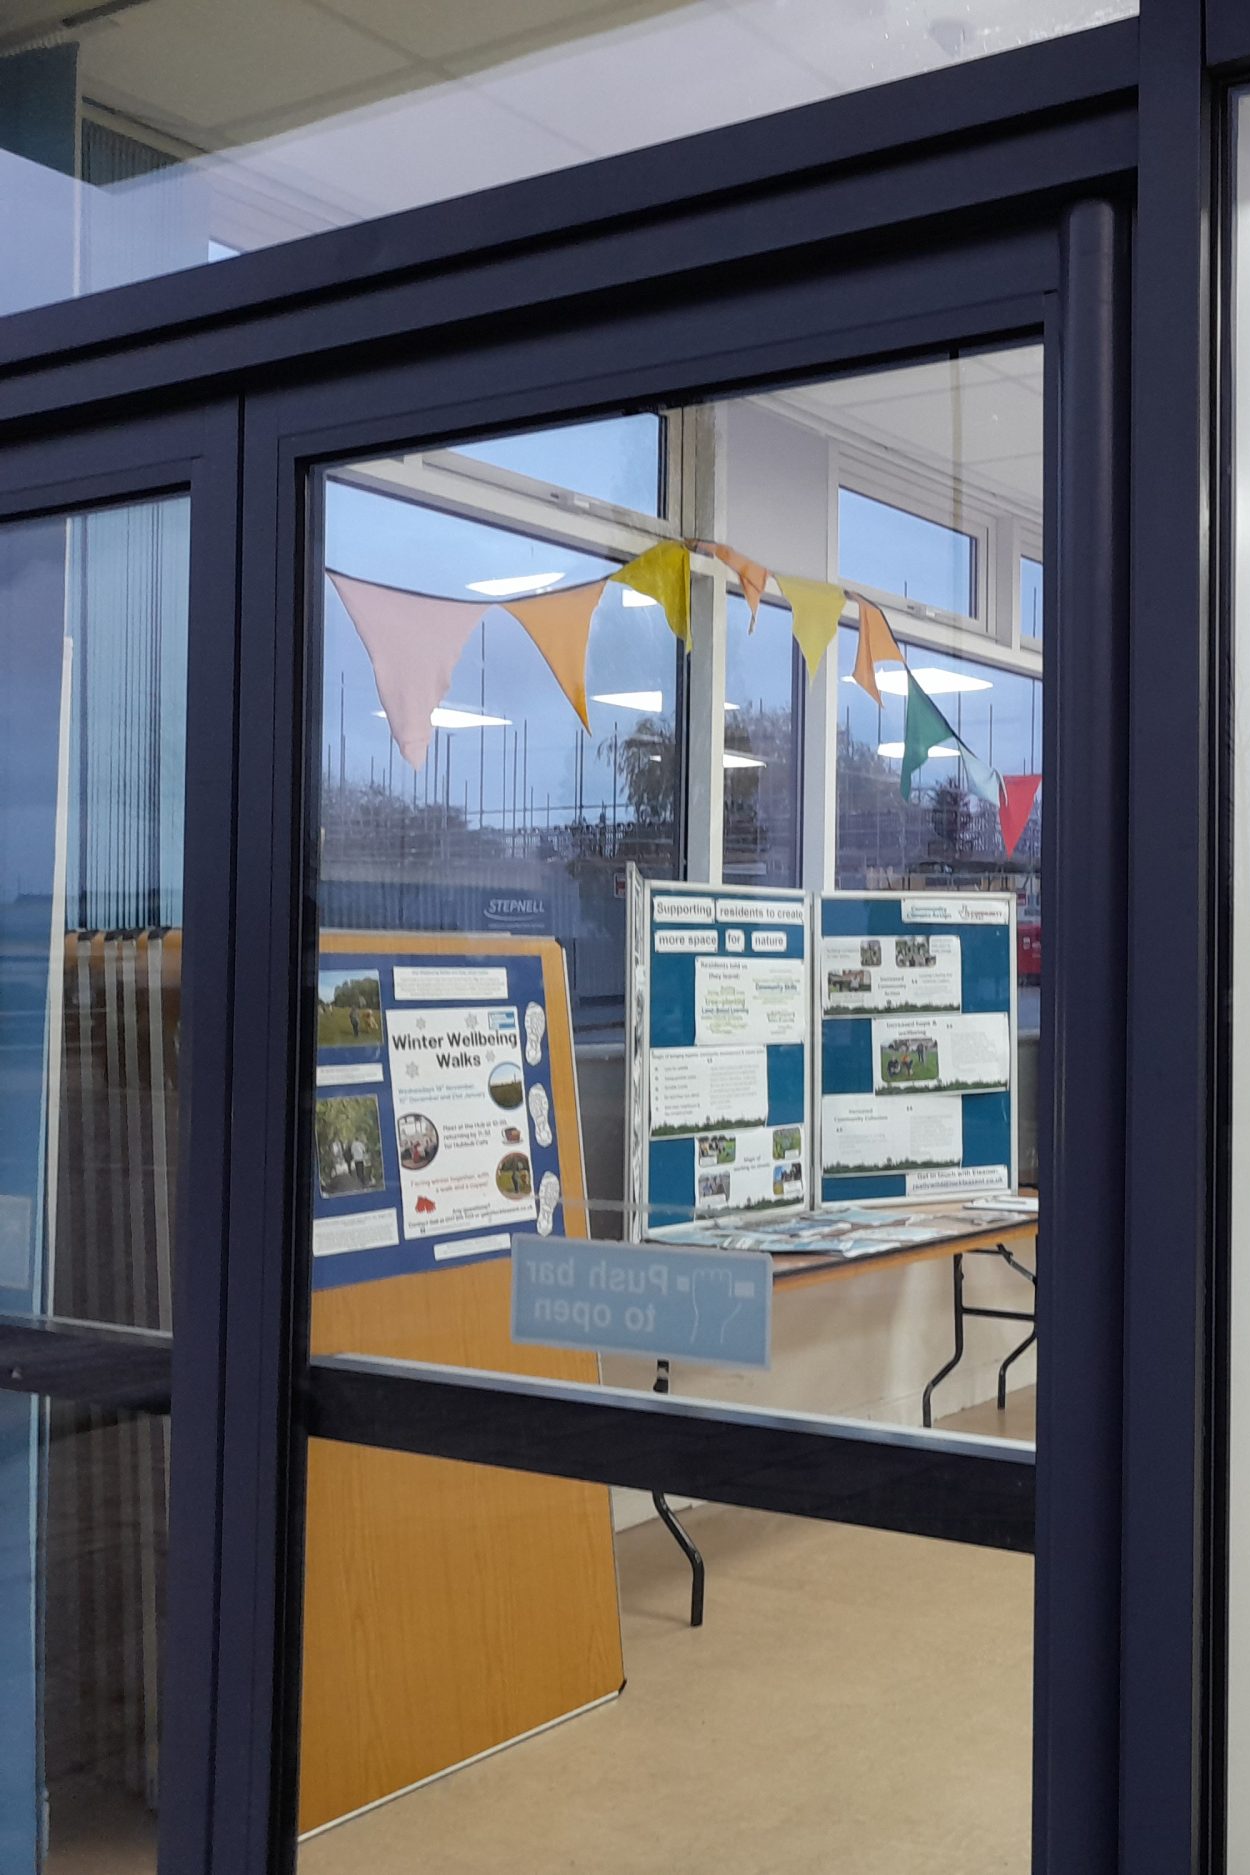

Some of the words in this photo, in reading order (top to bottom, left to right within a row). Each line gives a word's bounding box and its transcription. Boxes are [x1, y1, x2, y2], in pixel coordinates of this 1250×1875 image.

[488, 898, 545, 914] STEPNELL
[656, 900, 712, 917] Supporting
[720, 906, 764, 918] residents
[766, 908, 775, 918] to
[777, 910, 803, 919] create
[658, 936, 686, 946] more
[687, 936, 717, 946] space
[727, 933, 741, 945] for
[754, 935, 784, 946] nature
[392, 1033, 444, 1051] Winter
[446, 1030, 518, 1050] Wellbeing
[436, 1053, 482, 1069] Walks
